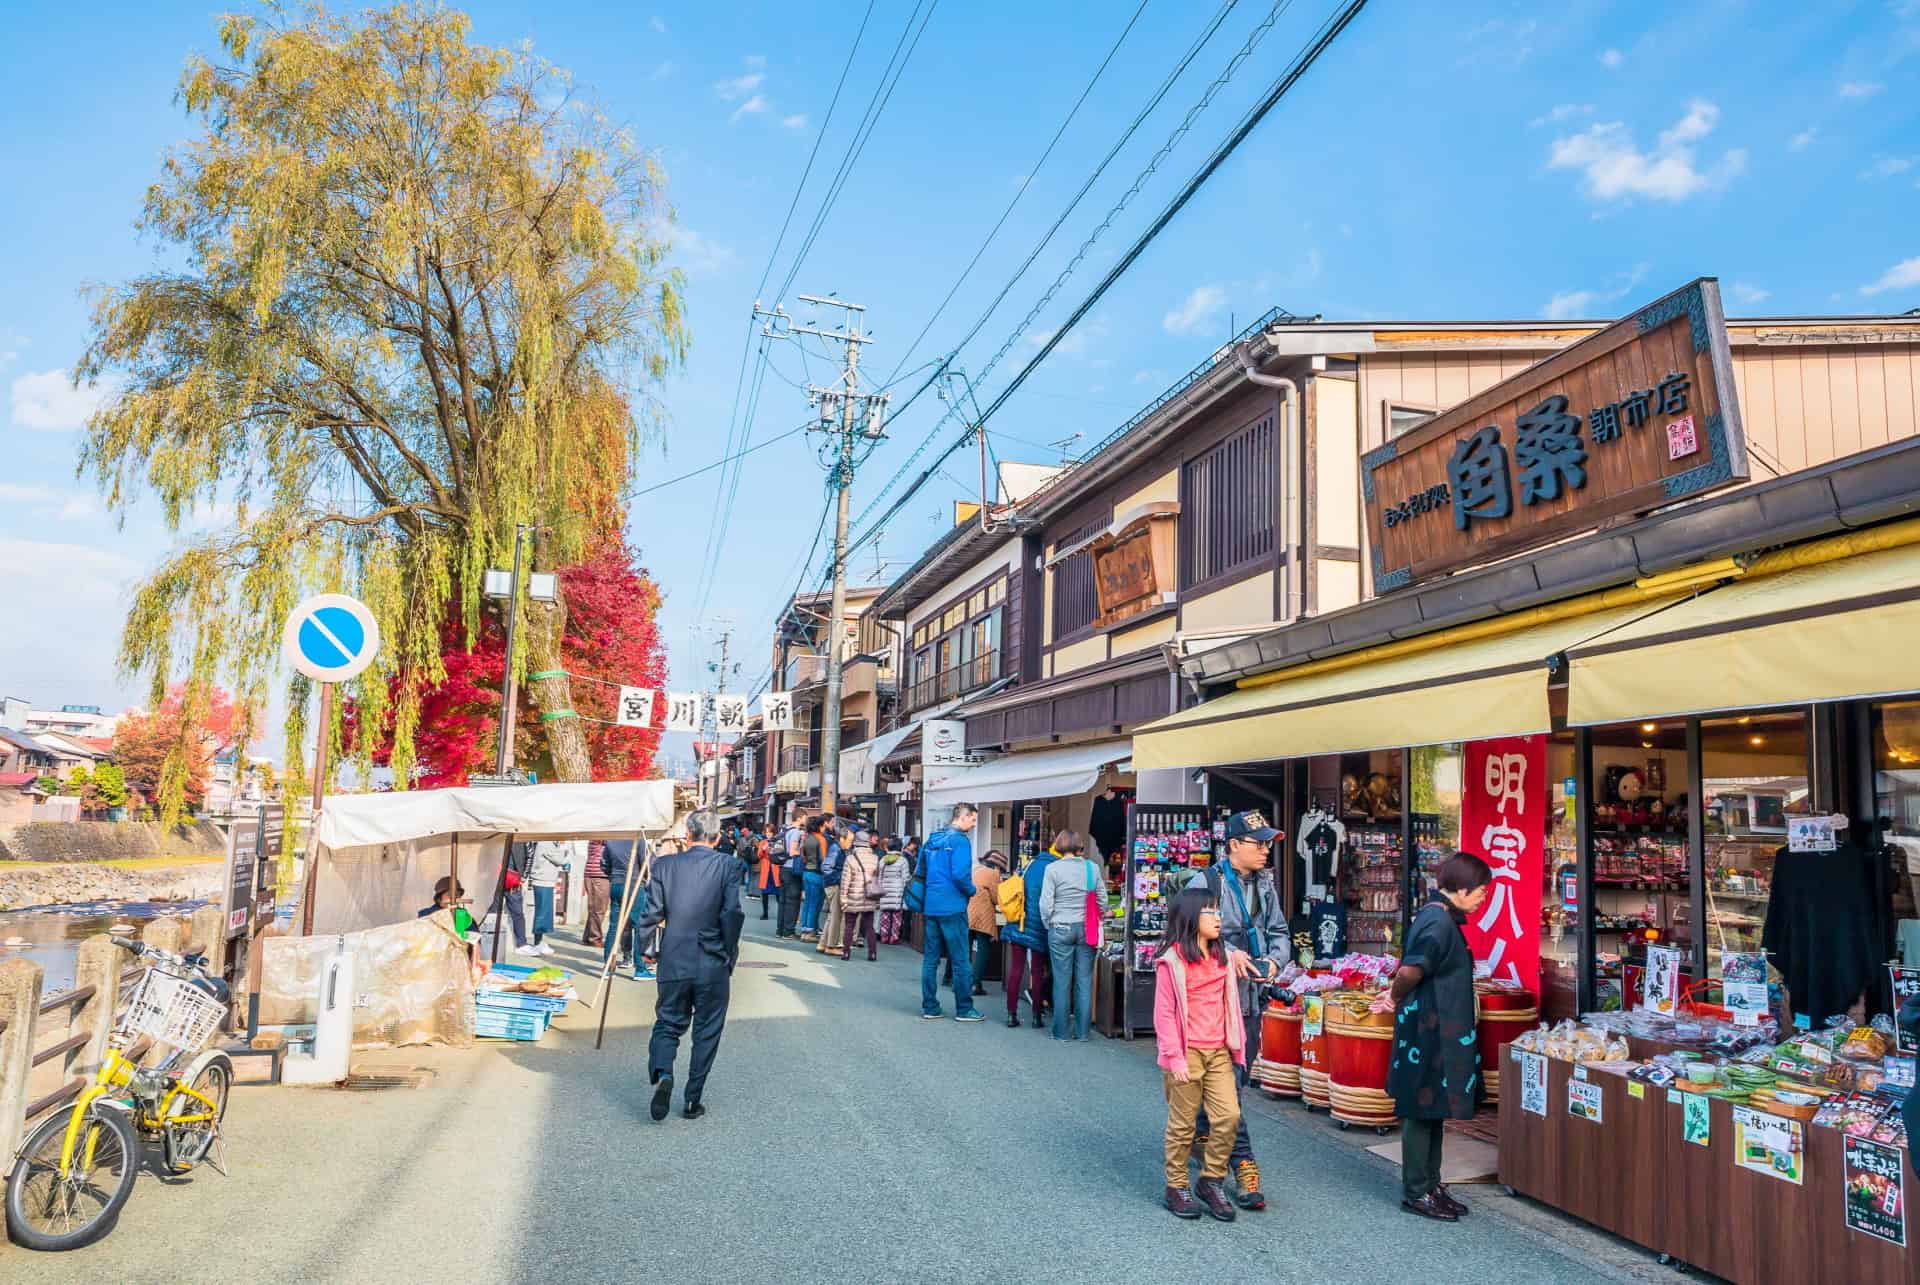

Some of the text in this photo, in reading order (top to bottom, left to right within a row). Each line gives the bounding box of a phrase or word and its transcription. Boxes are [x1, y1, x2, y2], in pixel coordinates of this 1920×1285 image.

[1589, 371, 1692, 445] 朝市店
[624, 693, 788, 727] 宮川朝市
[1477, 753, 1528, 989] 明宝ハム
